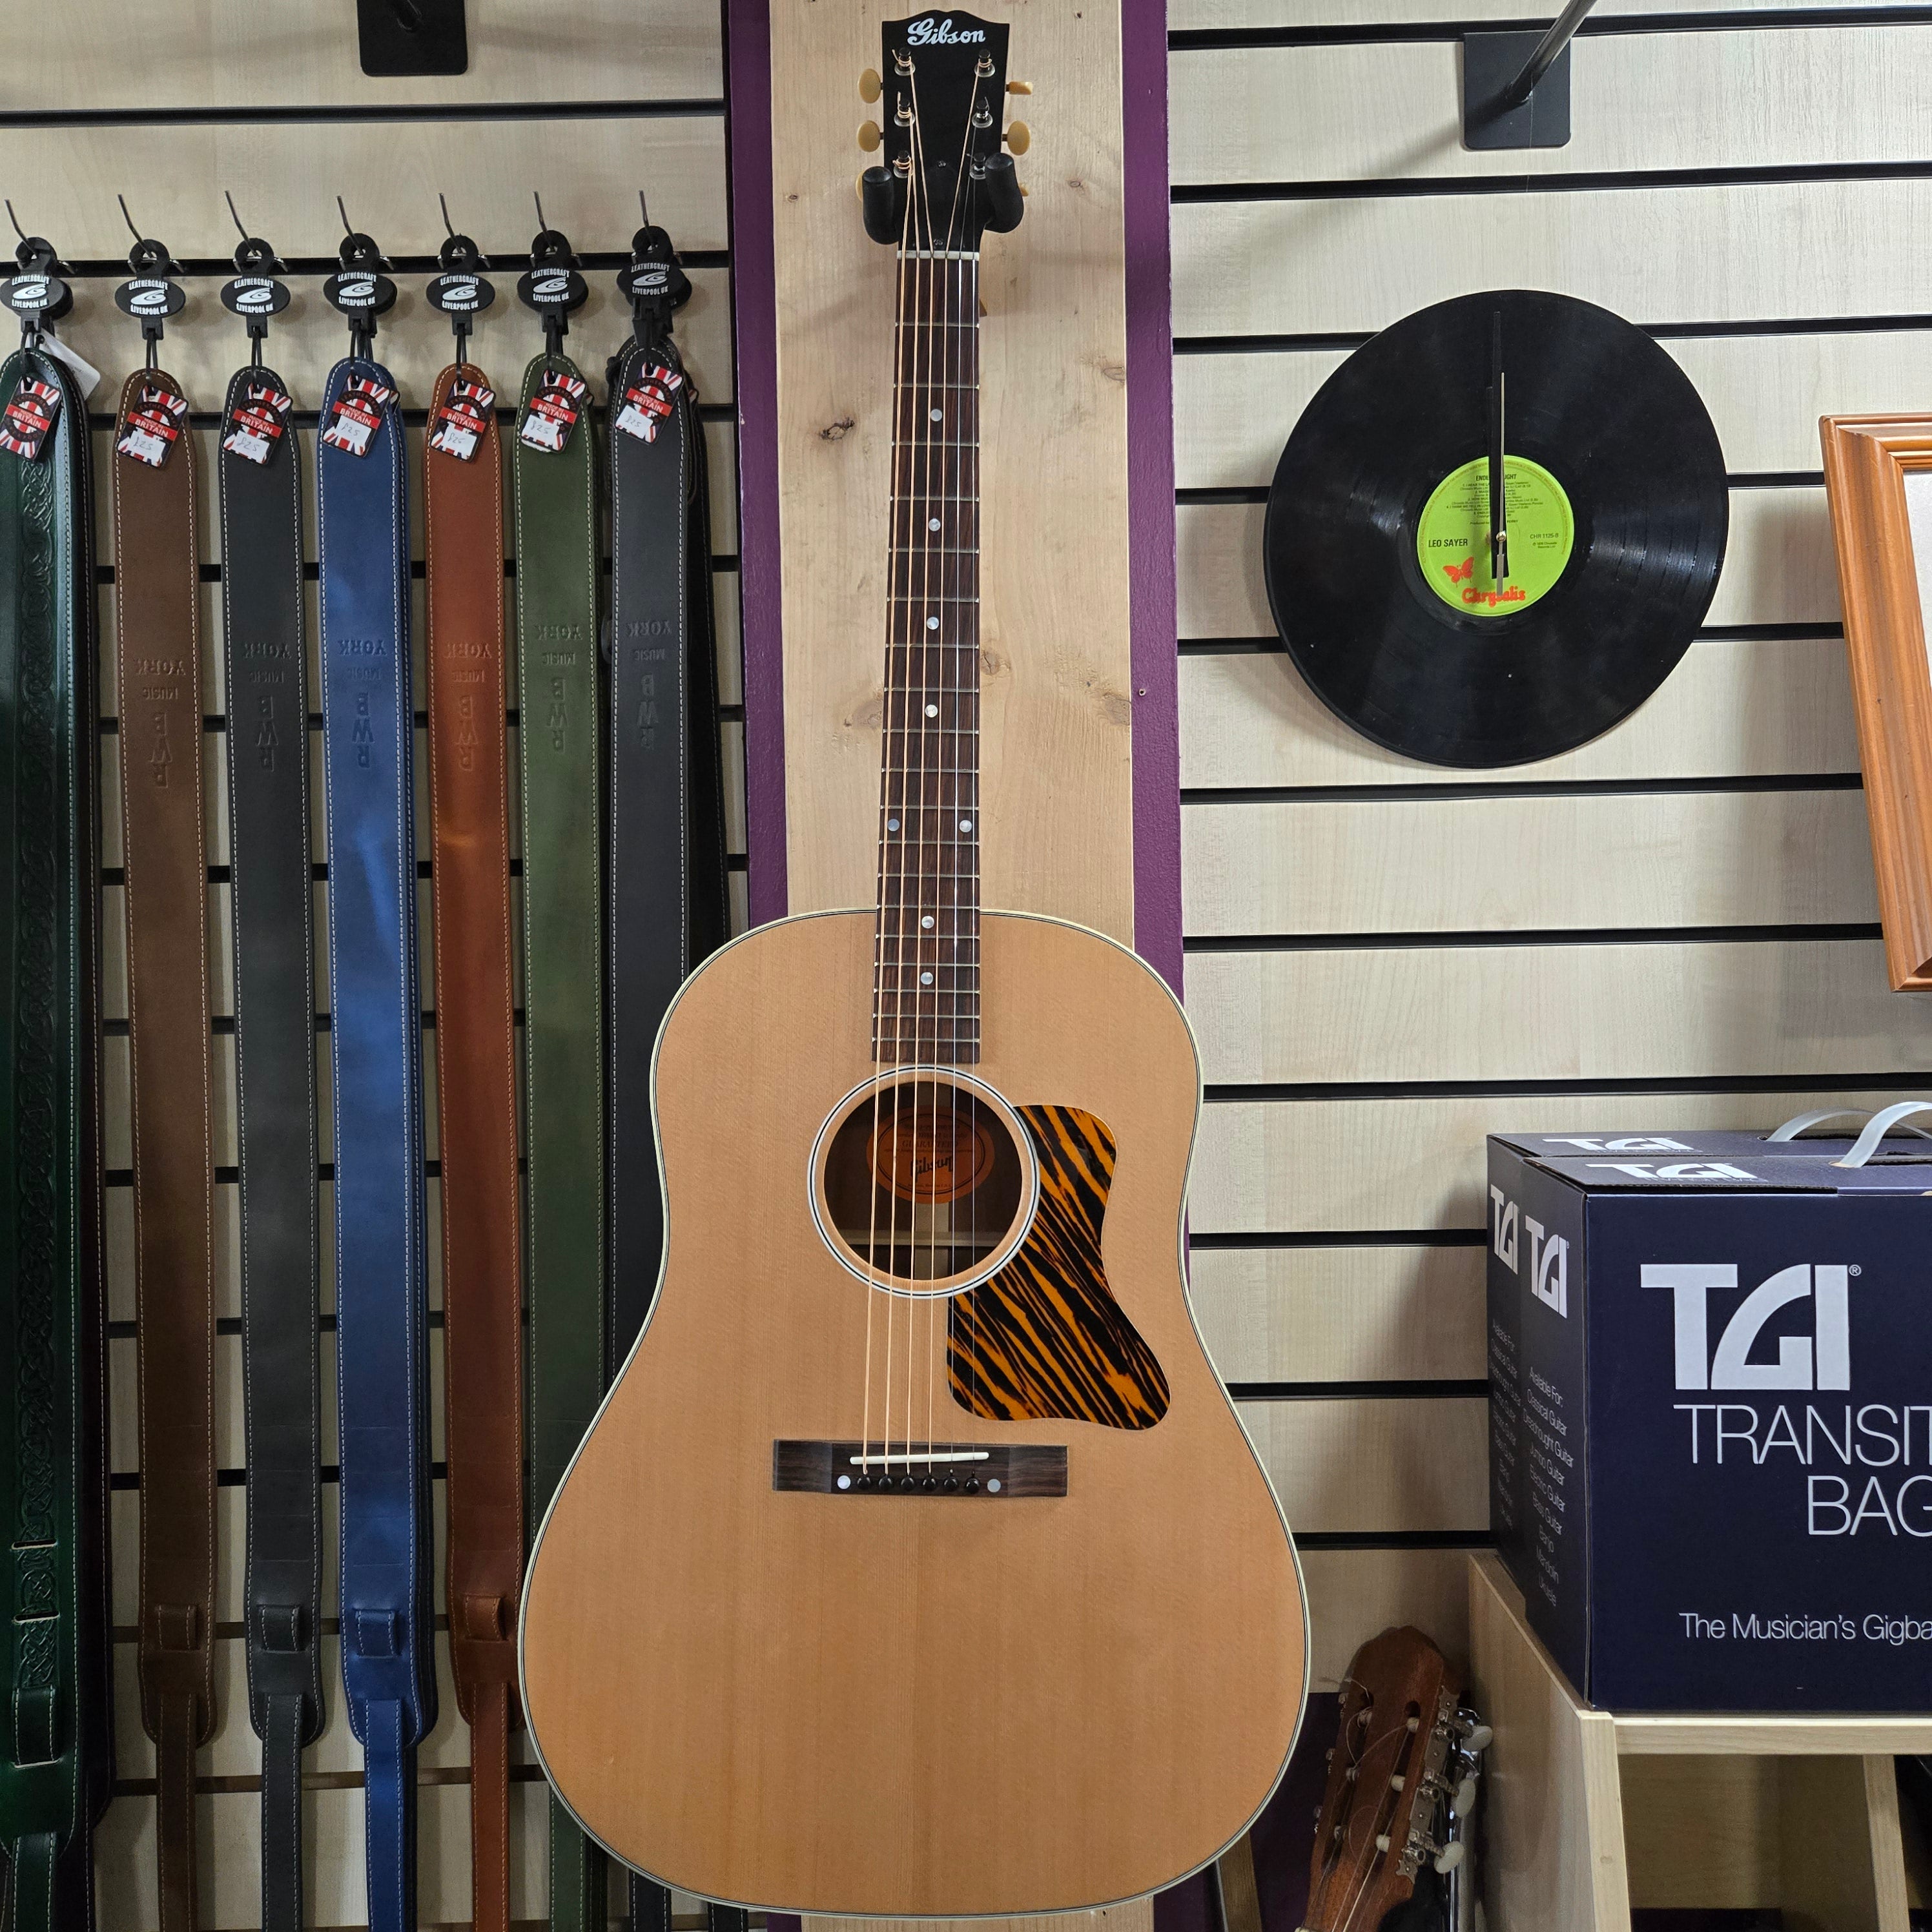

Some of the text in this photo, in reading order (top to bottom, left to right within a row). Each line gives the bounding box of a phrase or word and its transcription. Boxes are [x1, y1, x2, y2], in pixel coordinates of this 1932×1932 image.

[907, 17, 986, 46] Gibson
[533, 292, 570, 302] LIVERPOOL UK
[632, 287, 660, 295] LIVERPOOL
[12, 299, 39, 308] LIVERPOOL
[130, 305, 169, 314] LIVERPOOL UK
[236, 303, 274, 313] LIVERPOOL UK
[338, 296, 375, 306] LIVERPOOL UK
[442, 300, 478, 310] LIVERPOOL UK
[633, 395, 664, 412] BRITAIN
[12, 411, 41, 427] BRITAIN
[340, 408, 372, 426] BRITAIN
[446, 413, 477, 429] BRITAIN
[537, 404, 569, 421] BRITAIN
[135, 419, 169, 437] BRITAIN
[240, 416, 273, 434] BRITAIN
[1428, 539, 1468, 548] LEO SAYER
[535, 623, 583, 641] YORK
[626, 619, 671, 636] YORK
[240, 642, 292, 659] YORK
[337, 639, 388, 656] YORK
[443, 642, 492, 659] YORK
[634, 648, 666, 662] MUSIC
[136, 659, 187, 676] YORK
[541, 652, 575, 666] MUSIC
[249, 670, 284, 684] MUSIC
[347, 667, 382, 681] MUSIC
[451, 669, 484, 682] MUSIC
[143, 687, 178, 700] MUSIC
[1543, 1137, 1695, 1150] TGI
[910, 1156, 955, 1183] Gibson
[1586, 1163, 1758, 1178] TGI
[1549, 1410, 1567, 1437] Guitar
[1673, 1404, 1932, 1466] TRANSIT
[1554, 1441, 1574, 1468] Guitar
[1547, 1459, 1565, 1486] Guitar
[1547, 1485, 1565, 1512] Guitar
[1807, 1475, 1932, 1537] BAG
[1545, 1508, 1562, 1535] Guitar
[1679, 1612, 1725, 1639] The
[1863, 1614, 1932, 1646] Gigba
